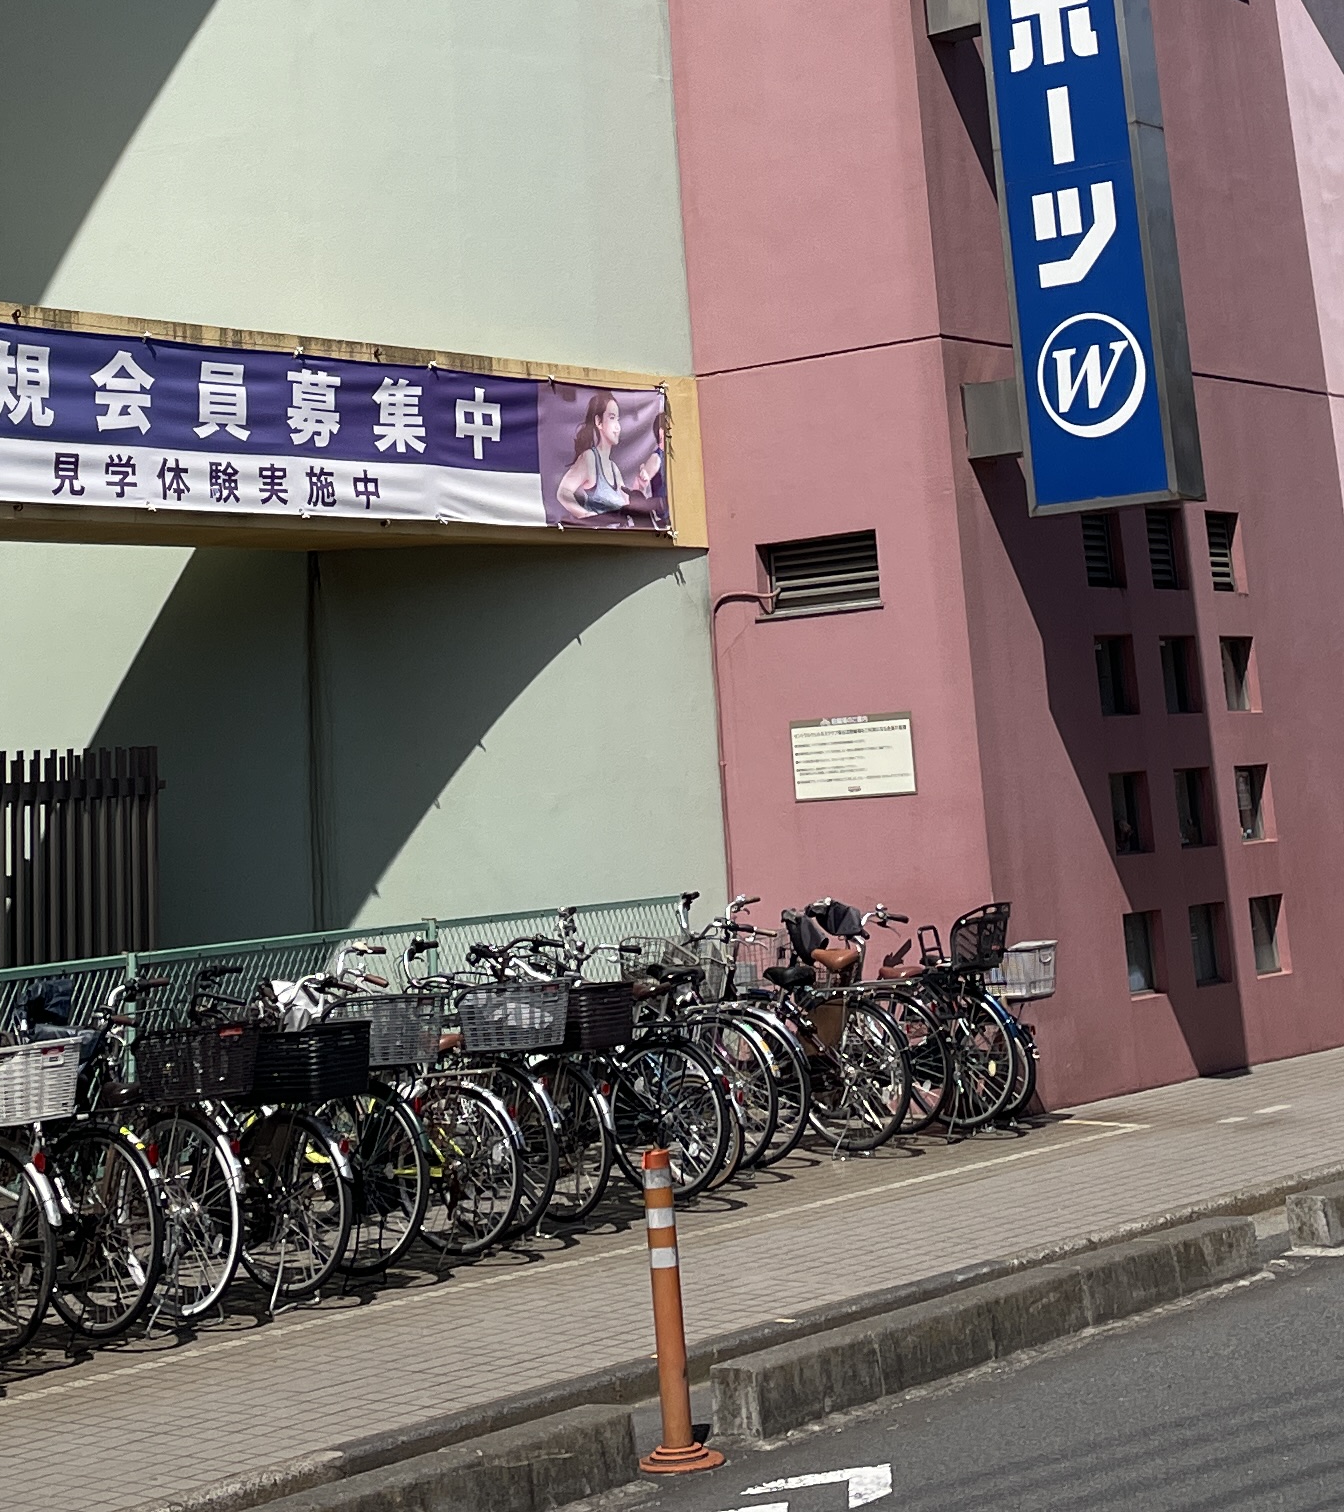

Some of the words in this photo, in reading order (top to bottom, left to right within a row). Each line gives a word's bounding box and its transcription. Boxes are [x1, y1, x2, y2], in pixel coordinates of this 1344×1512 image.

[52, 451, 383, 512] 見学体験実施中
